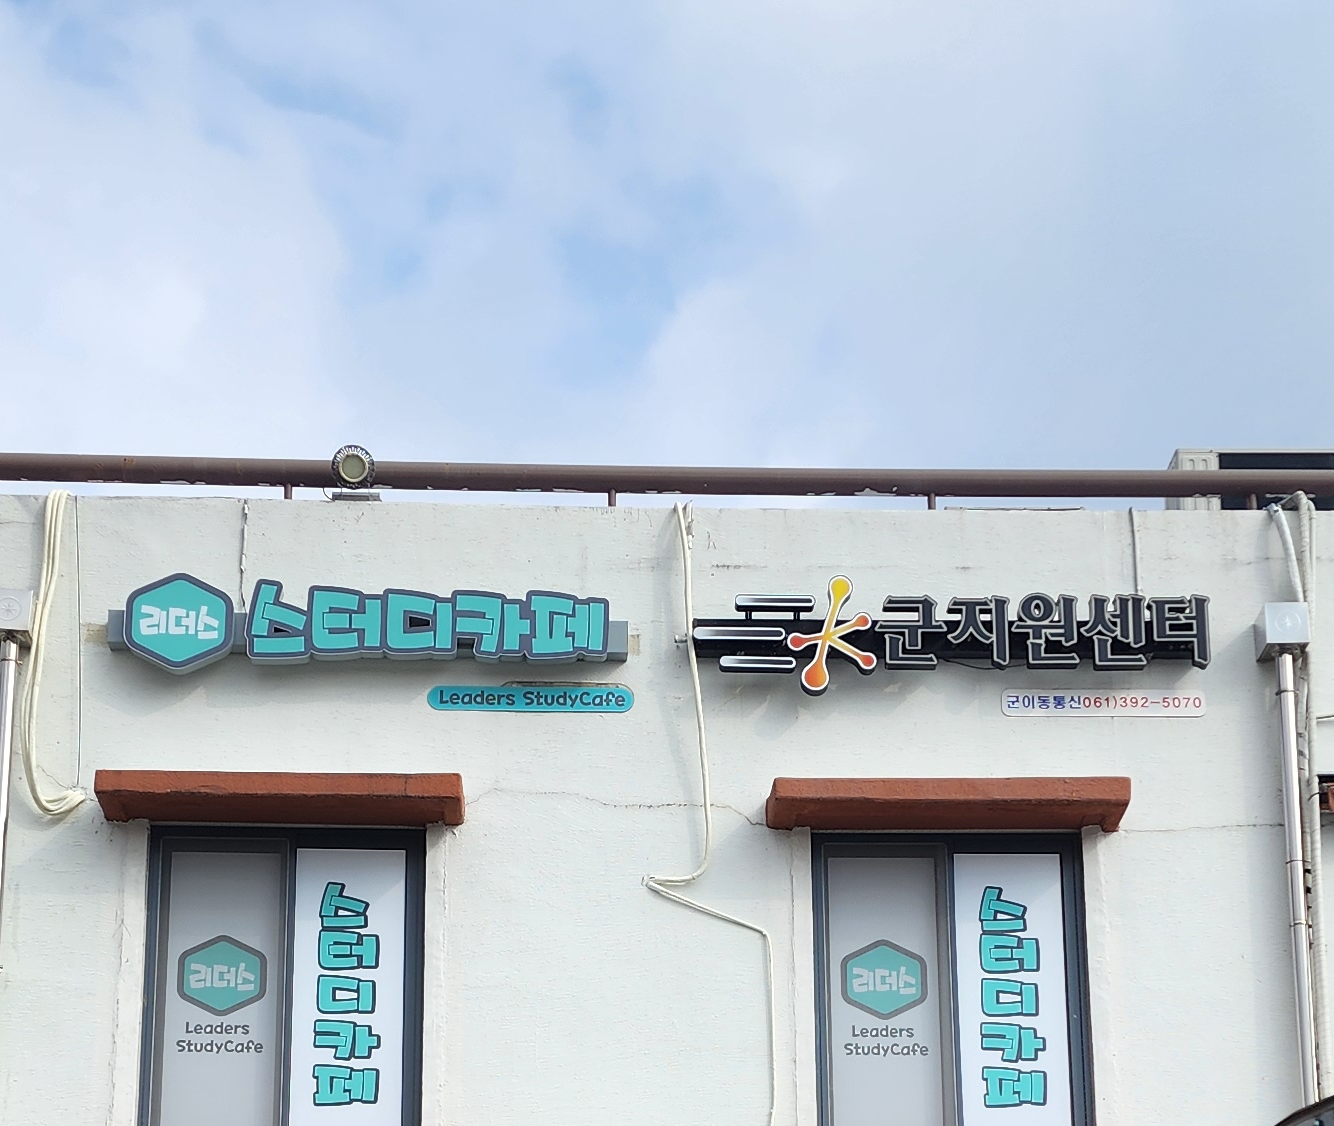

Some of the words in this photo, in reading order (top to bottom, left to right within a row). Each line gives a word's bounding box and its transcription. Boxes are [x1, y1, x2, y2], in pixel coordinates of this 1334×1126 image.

[139, 604, 220, 640] 리더스
[249, 580, 609, 660] 스터디카페
[875, 592, 1211, 670] 군지원센터
[439, 689, 516, 706] Leaders
[522, 690, 626, 709] StudyCafe
[188, 961, 256, 992] 리더스
[852, 965, 917, 996] 리더스
[312, 881, 381, 1107] 스터디카페
[978, 885, 1047, 1109] 스터디카페
[185, 1021, 250, 1035] Leaders
[851, 1025, 915, 1038] Leaders
[176, 1039, 264, 1054] StudyCafe
[844, 1043, 929, 1057] StudyCafe
